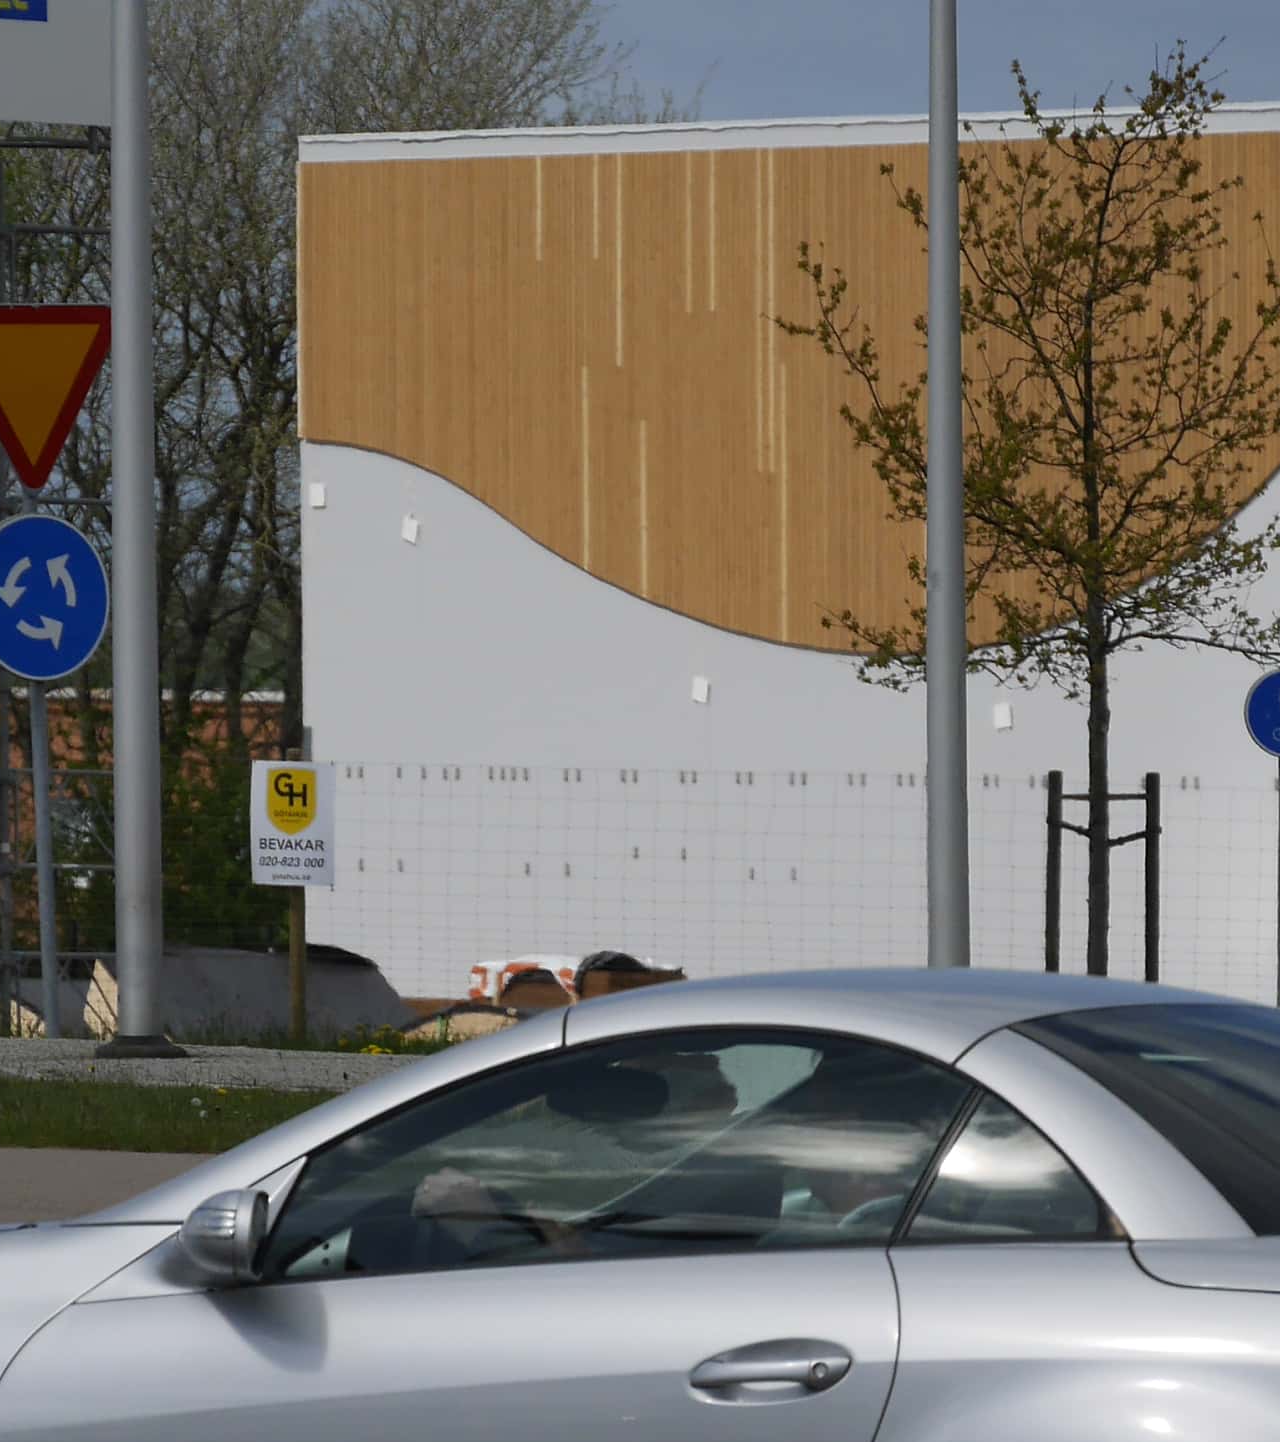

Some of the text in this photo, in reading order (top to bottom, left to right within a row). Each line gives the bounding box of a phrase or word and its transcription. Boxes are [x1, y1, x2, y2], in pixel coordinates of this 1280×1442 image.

[273, 772, 308, 808] GH
[258, 838, 325, 851] BEVAKAR
[258, 855, 324, 869] 020-823 000
